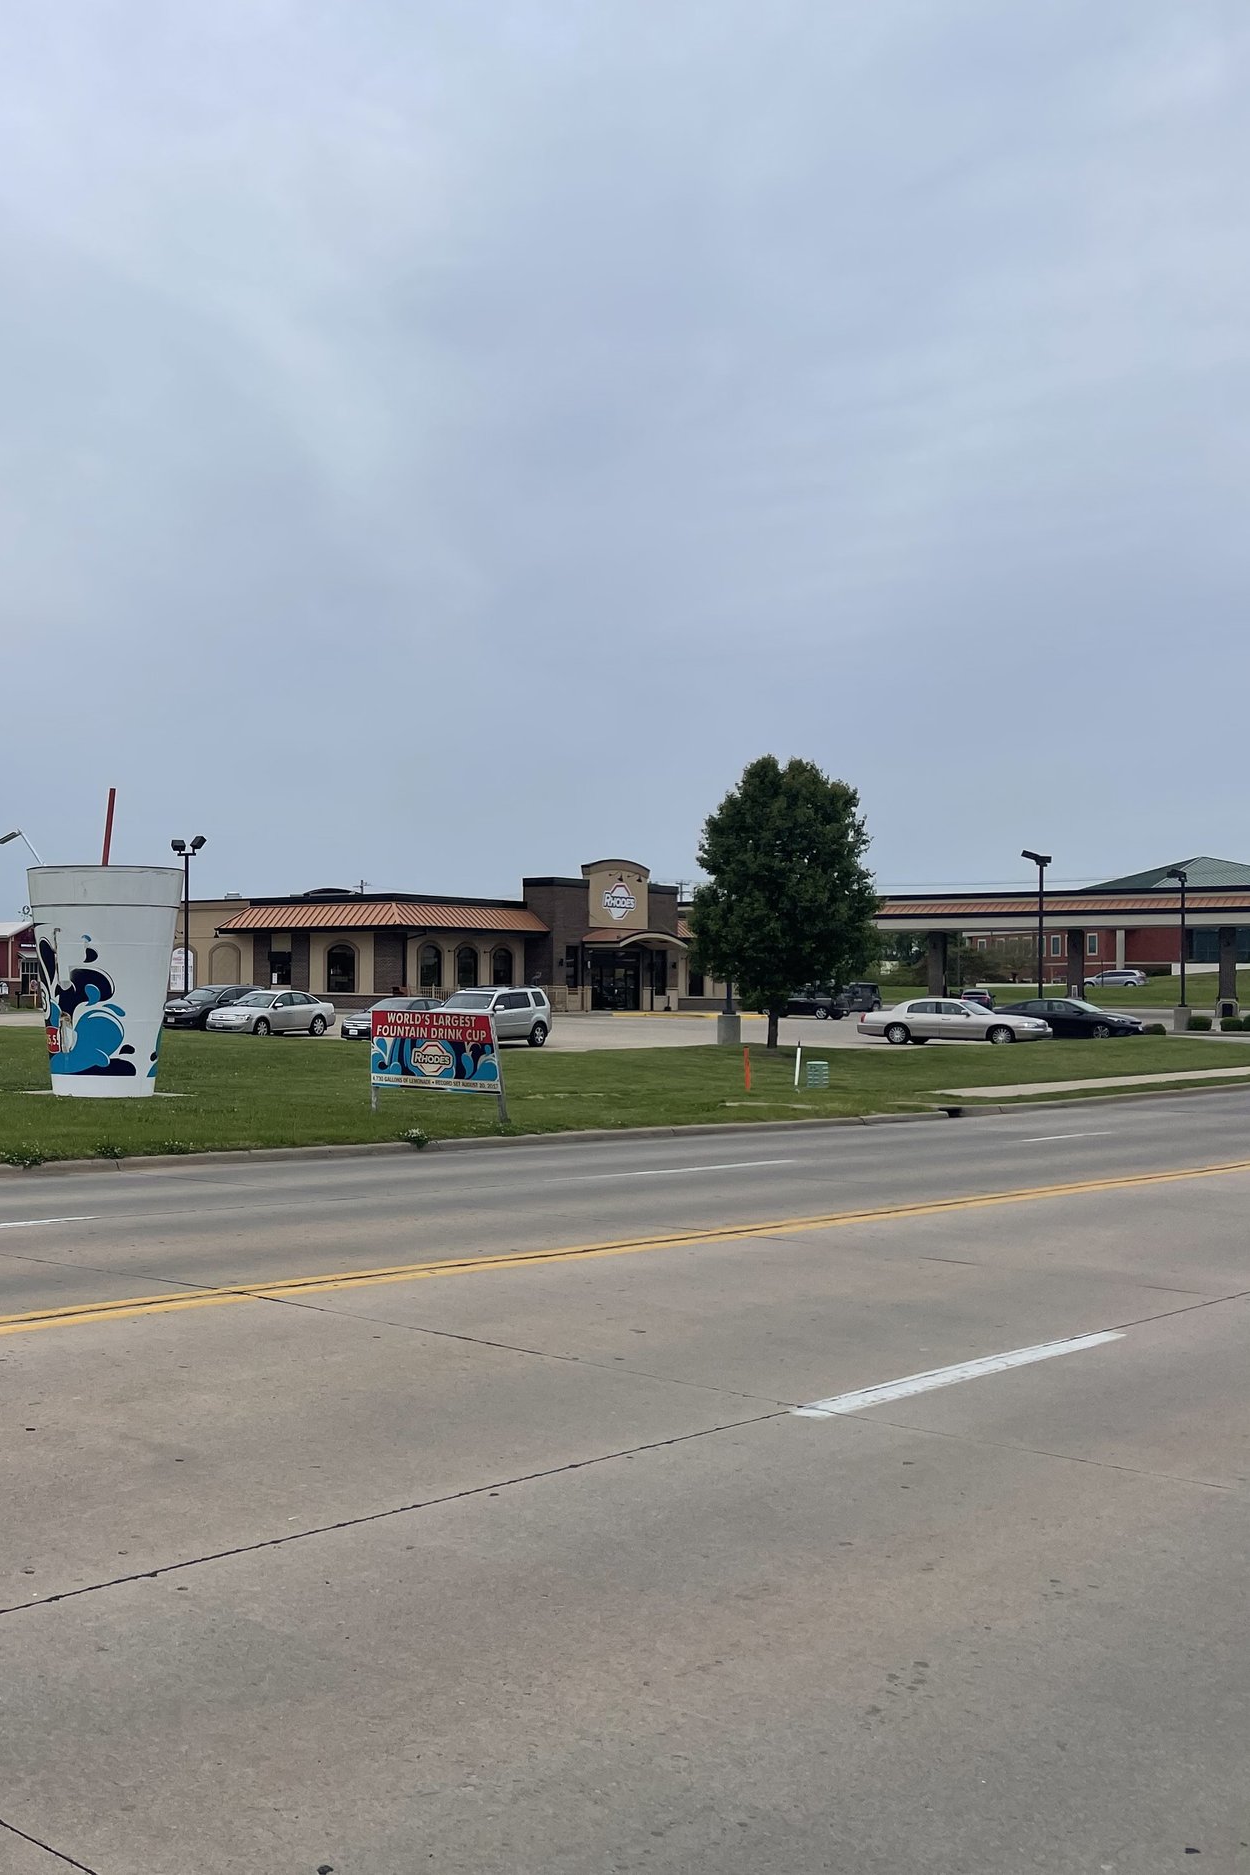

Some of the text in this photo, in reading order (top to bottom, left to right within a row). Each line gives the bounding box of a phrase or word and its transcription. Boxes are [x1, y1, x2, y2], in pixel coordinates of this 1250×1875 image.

[604, 892, 636, 909] RHODES
[387, 1012, 476, 1027] WORLD'S LARGEST
[376, 1025, 487, 1041] FOUNTAIN DRINK CUP
[414, 1051, 450, 1065] RHODES
